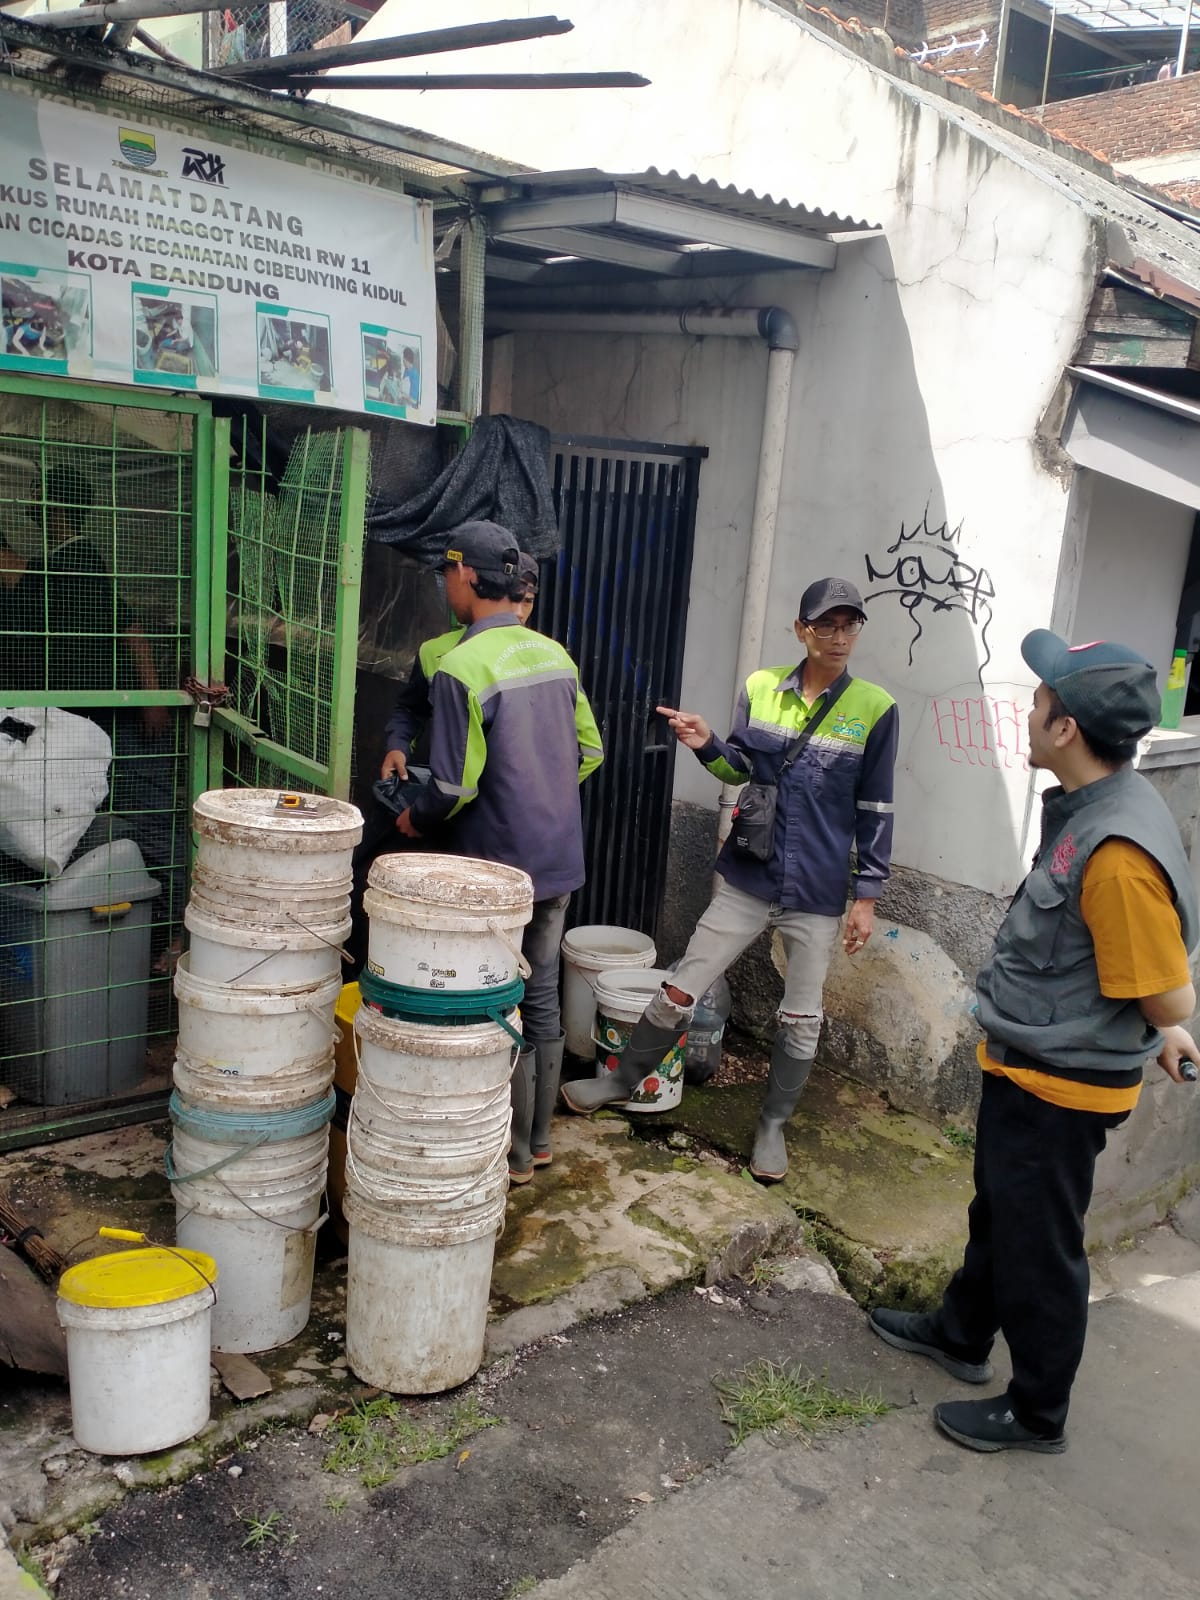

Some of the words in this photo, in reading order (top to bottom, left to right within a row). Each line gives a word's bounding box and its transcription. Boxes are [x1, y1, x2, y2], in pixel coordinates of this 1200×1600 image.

[28, 157, 182, 209] SELAMAT
[189, 192, 304, 237] DATANG
[55, 194, 140, 227] RUMAH
[146, 212, 235, 245] MAGGOT
[239, 231, 312, 262] KENARI
[316, 248, 346, 269] RW
[351, 257, 371, 276] 11
[28, 216, 124, 248] CICADAS
[129, 233, 248, 272] KECAMATAN
[253, 258, 358, 295] CIBEUNYING
[361, 281, 407, 307] KIDUL
[67, 249, 142, 278] KOTA
[150, 262, 280, 301] BANDUNG
